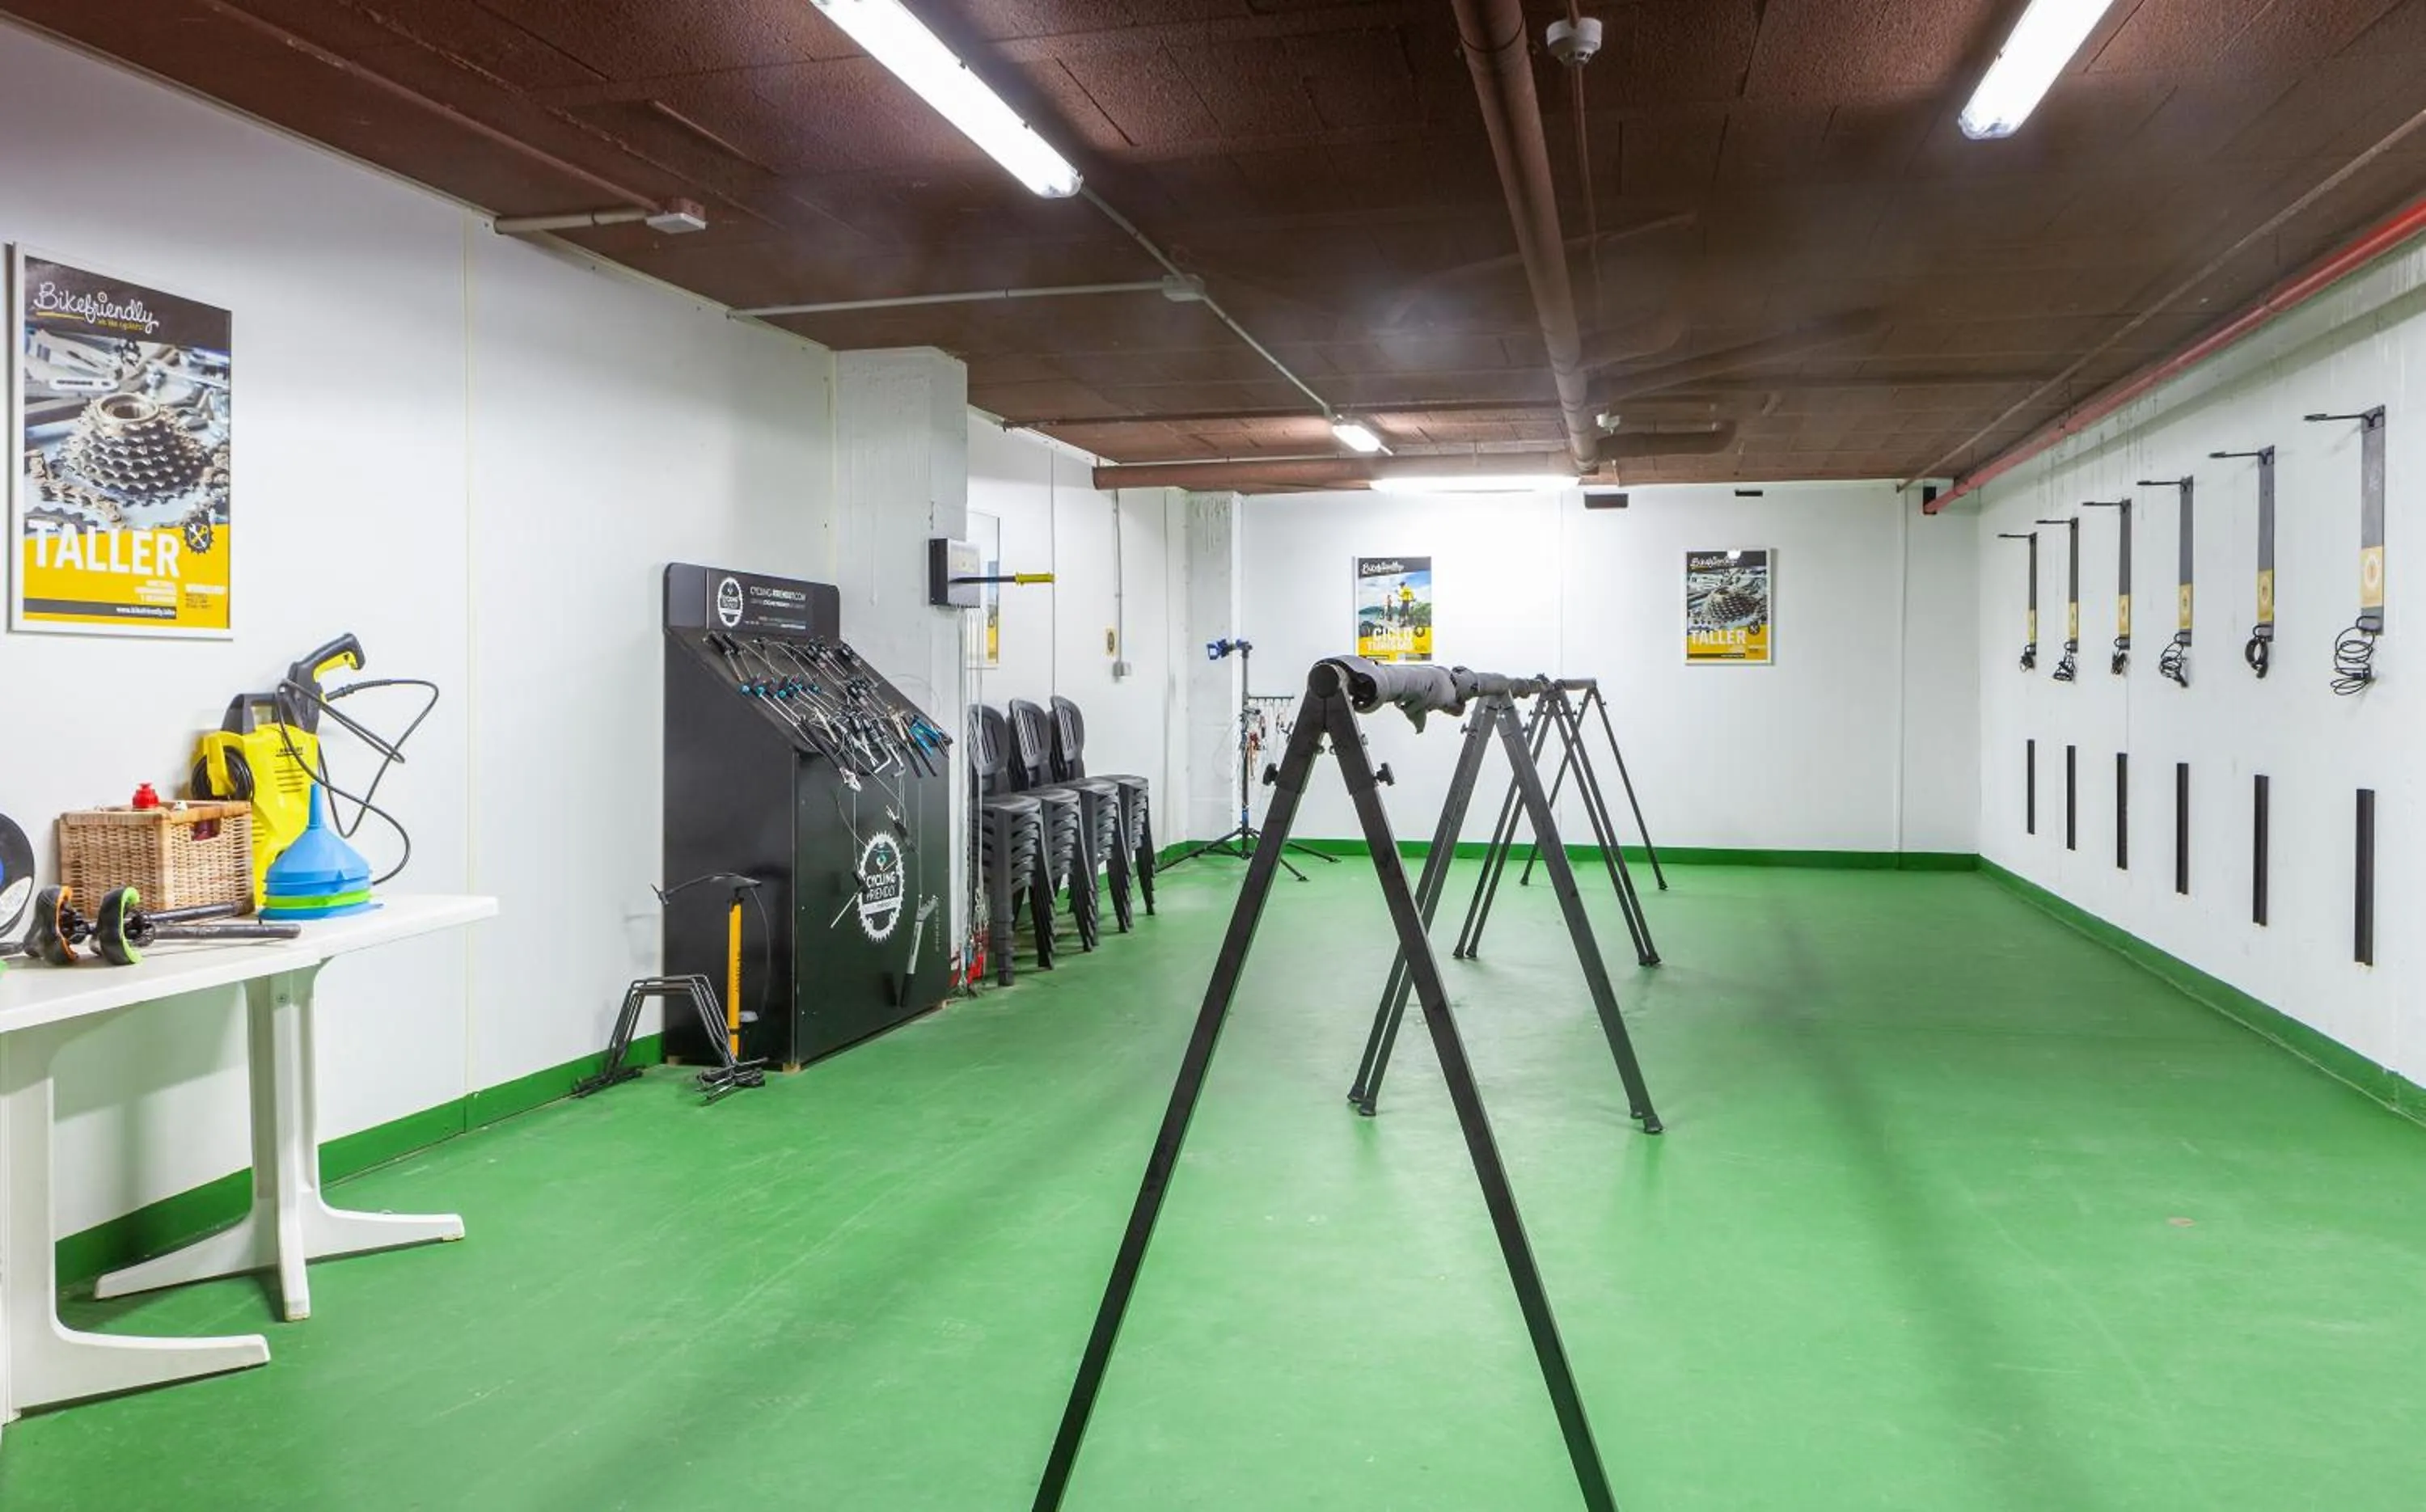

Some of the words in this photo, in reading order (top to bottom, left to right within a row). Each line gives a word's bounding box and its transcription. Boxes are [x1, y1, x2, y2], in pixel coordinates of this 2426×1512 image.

[34, 281, 159, 333] Bikefriendly
[28, 520, 180, 577] TALLER
[1689, 630, 1746, 645] TALLER
[866, 871, 896, 888] CYCLING
